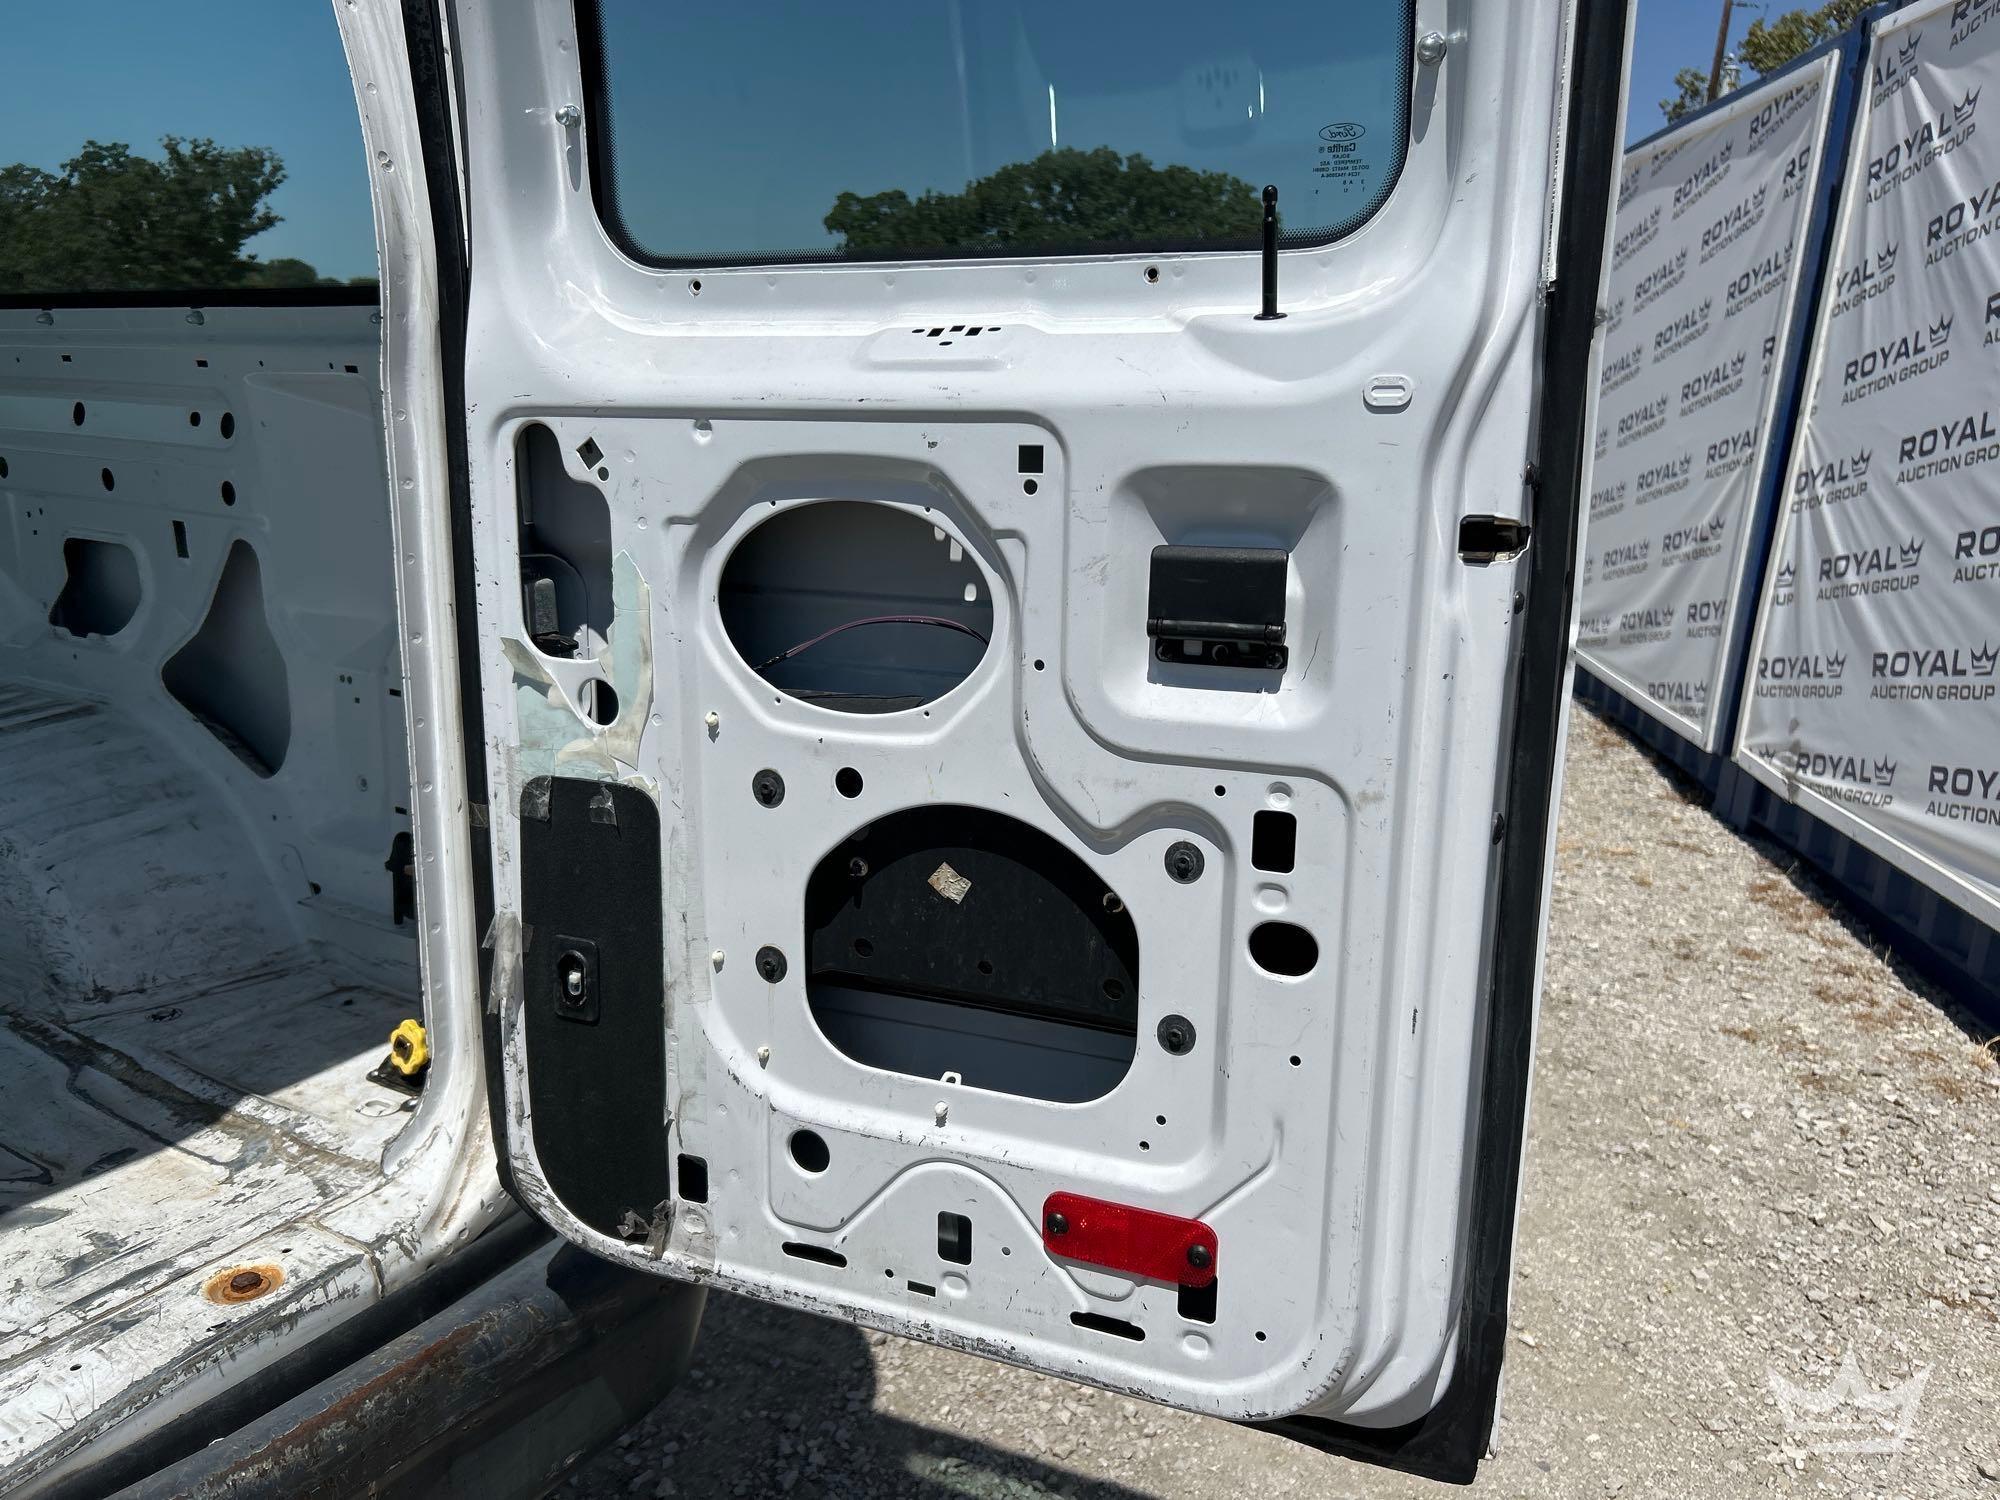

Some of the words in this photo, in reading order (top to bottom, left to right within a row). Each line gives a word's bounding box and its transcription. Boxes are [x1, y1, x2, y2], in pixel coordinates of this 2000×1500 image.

[1874, 65, 1919, 109] GROUP
[1866, 158, 1922, 206] AUCTION
[1923, 123, 1976, 167] GROUP
[1867, 112, 1952, 187] ROYAL
[1673, 158, 1719, 208] ROYAL
[1701, 197, 1751, 251] ROYAL
[1925, 220, 1992, 269] AUCTION
[1634, 260, 1674, 301] ROYAL
[1726, 252, 1783, 302] ROYAL
[1852, 274, 1896, 309] GROUP
[1724, 290, 1761, 320] AUCTION
[1653, 307, 1698, 351] ROYAL
[1844, 330, 1926, 387] ROYAL
[1680, 363, 1730, 404] ROYAL
[1841, 371, 1898, 407] AUCTION
[1899, 350, 1950, 383] GROUP
[1617, 402, 1657, 437] ROYAL
[1899, 411, 1996, 465] ROYAL
[1636, 459, 1678, 492] ROYAL
[1704, 455, 1740, 481] AUCTION
[1896, 455, 1962, 486] AUCTION
[1827, 481, 1868, 506] GROUP
[1662, 523, 1709, 553] ROYAL
[1602, 544, 1637, 568] ROYAL
[1819, 546, 1898, 582] ROYAL
[1817, 582, 1869, 601] AUCTION
[1872, 574, 1920, 594] GROUP
[1619, 607, 1662, 631] ROYAL
[1758, 655, 1824, 680] ROYAL
[1872, 648, 1967, 678] ROYAL
[1648, 681, 1693, 701] ROYAL
[1802, 685, 1842, 699] GROUP
[1870, 685, 1933, 700] AUCTION
[1936, 684, 1995, 701] GROUP
[1795, 752, 1872, 784] ROYAL
[1928, 765, 2000, 801] ROY
[1843, 788, 1893, 808] GROUP
